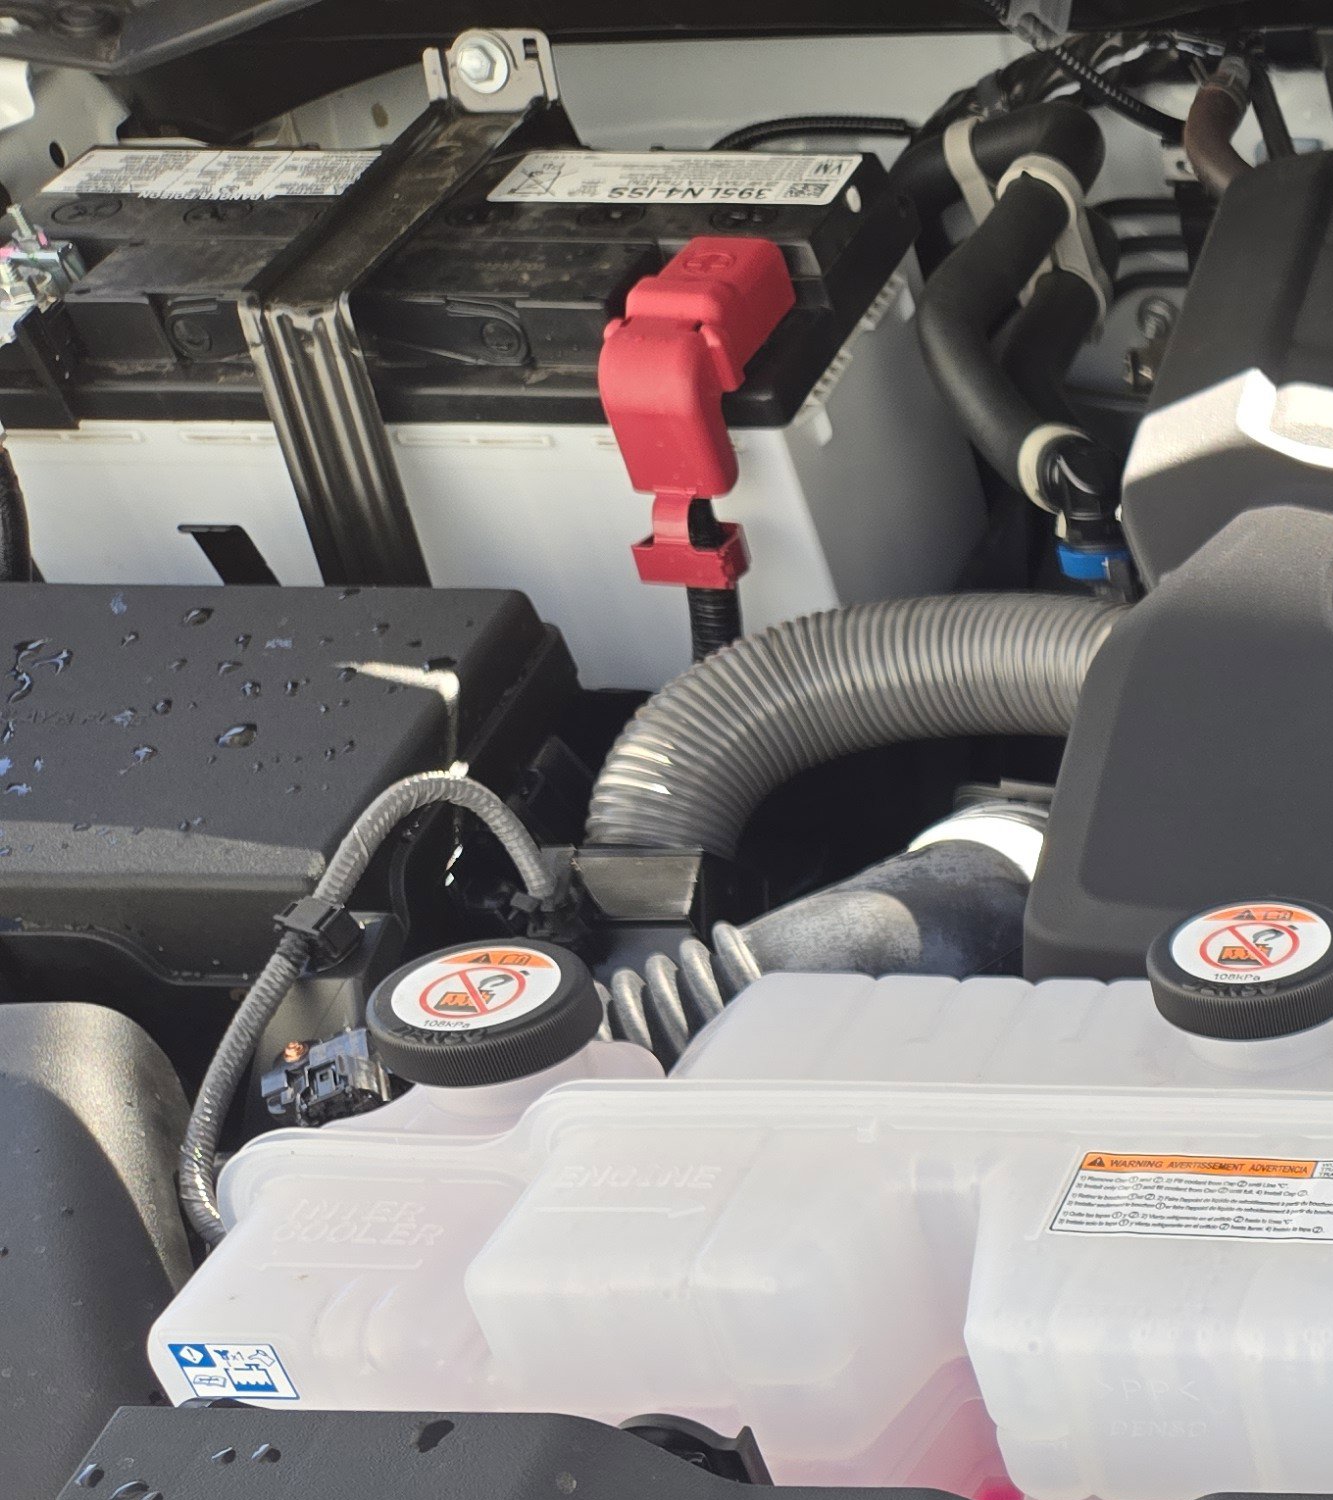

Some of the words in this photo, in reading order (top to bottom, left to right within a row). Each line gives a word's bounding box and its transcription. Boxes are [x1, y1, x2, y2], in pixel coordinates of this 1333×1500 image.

[551, 1165, 721, 1187] ENGINE
[1108, 1159, 1163, 1168] WARNING
[1166, 1161, 1245, 1171] AVERTISSEMENT
[1248, 1163, 1309, 1173] ADVERTENCIA
[272, 1222, 444, 1246] COOLER
